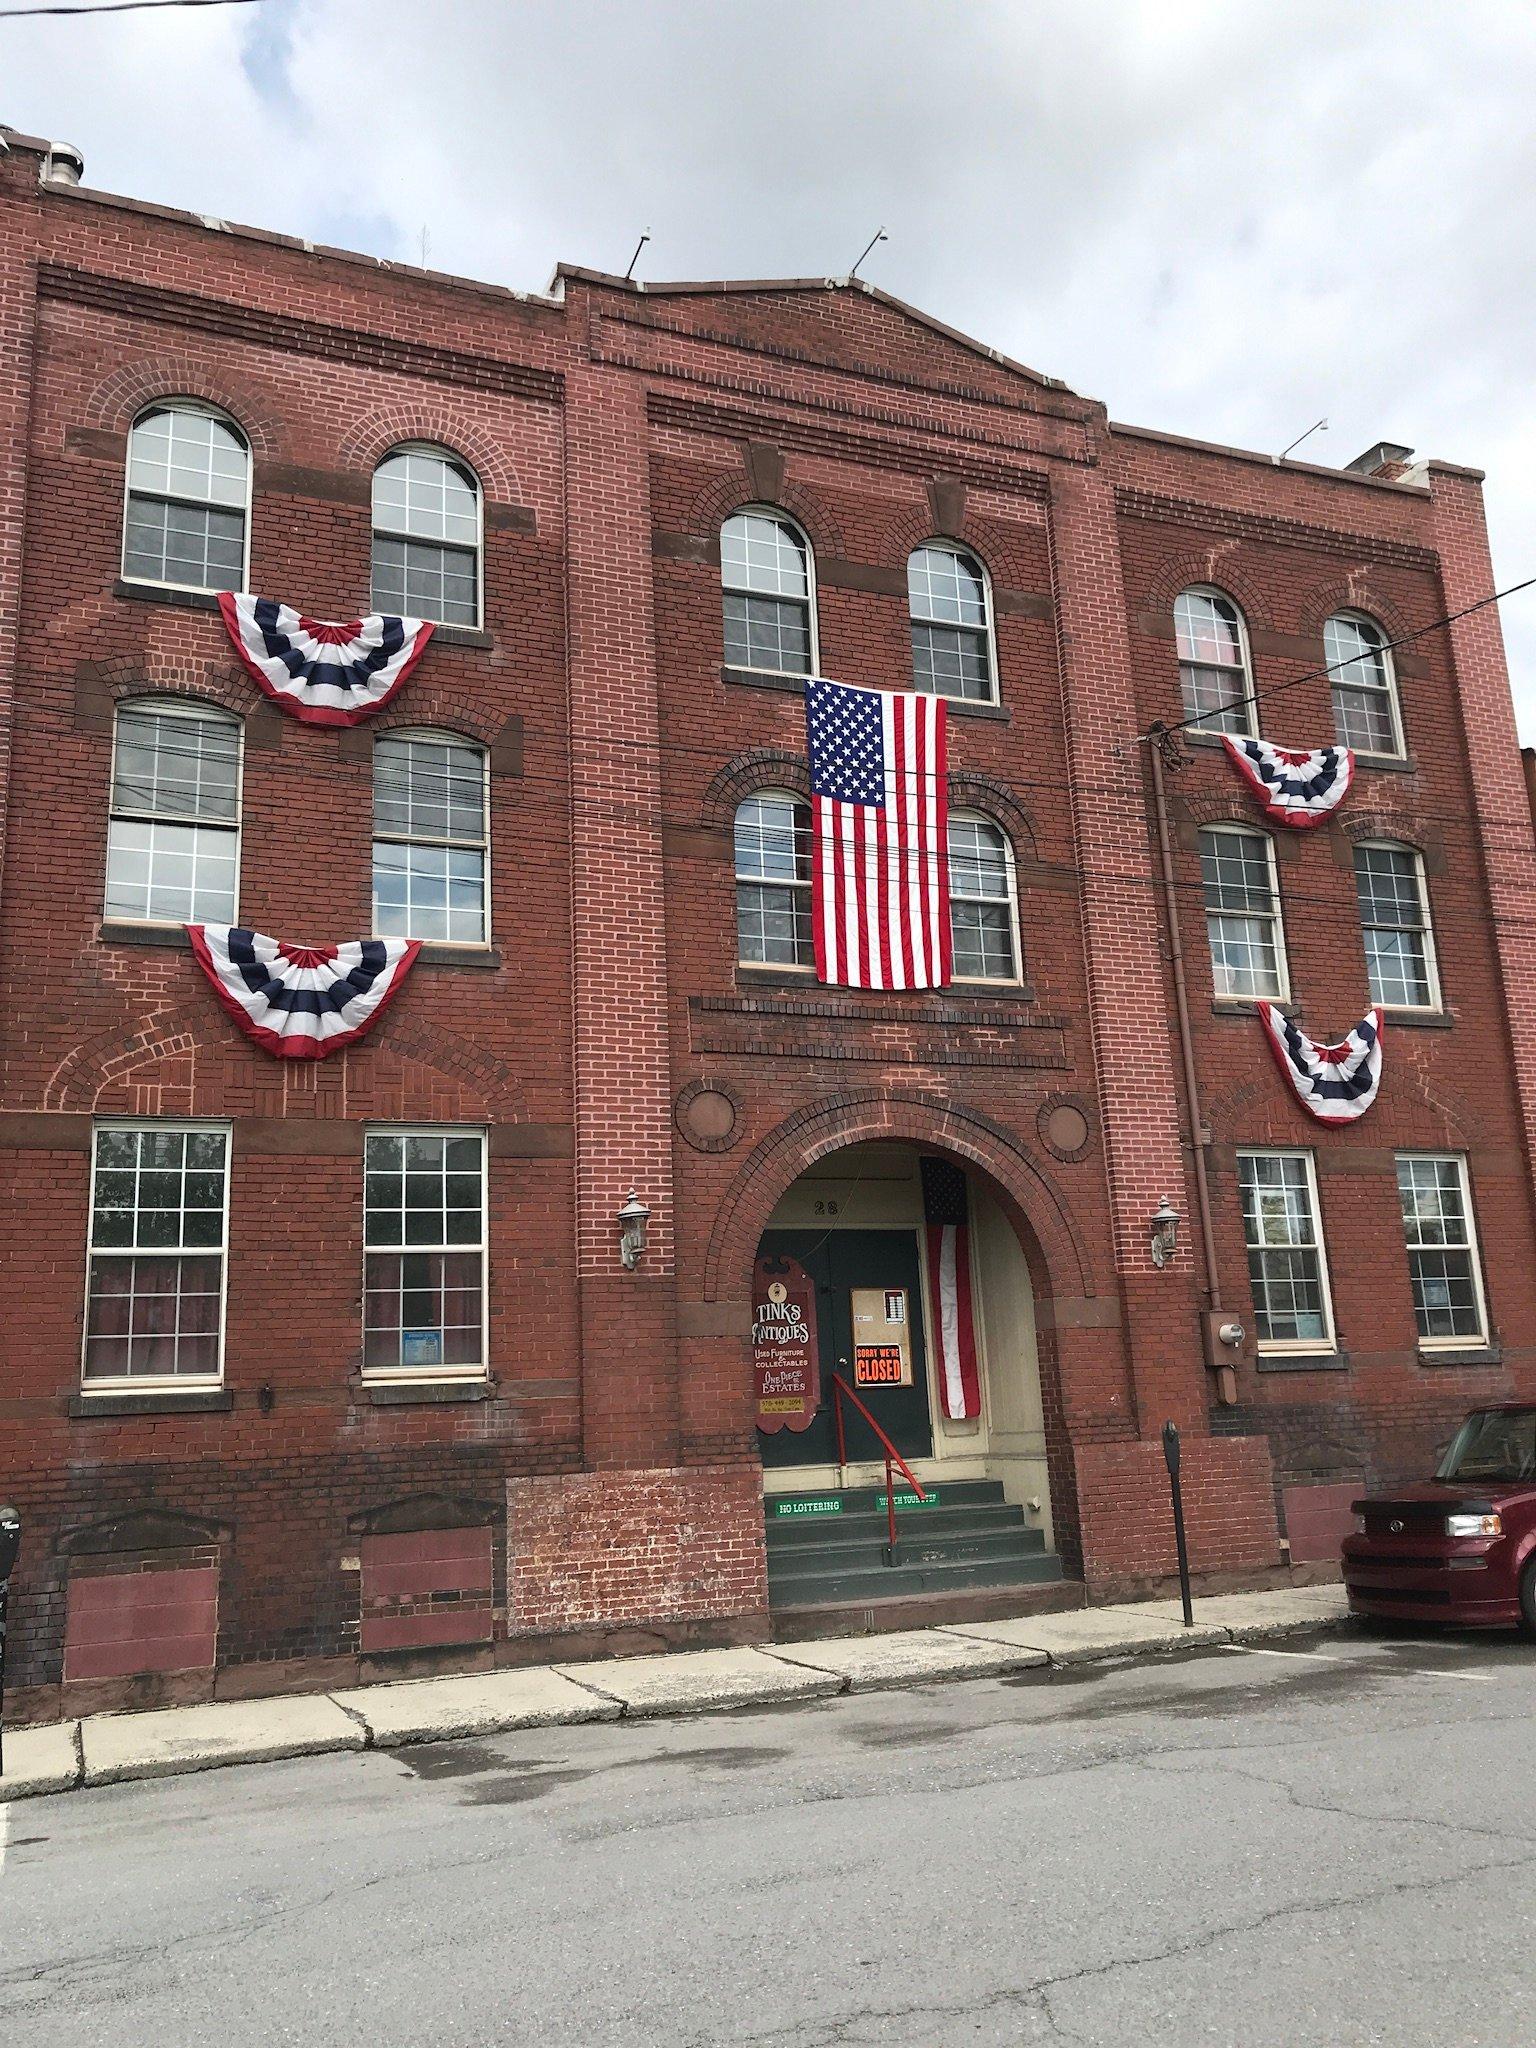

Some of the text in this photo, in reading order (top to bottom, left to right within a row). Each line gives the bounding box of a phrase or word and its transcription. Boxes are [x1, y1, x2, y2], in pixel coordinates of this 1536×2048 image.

[815, 1200, 838, 1216] 28
[755, 1303, 802, 1325] TINKS
[752, 1322, 809, 1345] ANTIQUES
[754, 1348, 804, 1360] USED FURNITURE
[857, 1348, 899, 1358] SORRY WE'RE
[755, 1360, 808, 1368] COLLECTABLES
[857, 1359, 900, 1381] CLOSED
[764, 1370, 803, 1385] ONE PIECE
[762, 1383, 806, 1394] ESTATES
[903, 1495, 920, 1504] YOUR
[779, 1501, 840, 1514] NO LOITERING
